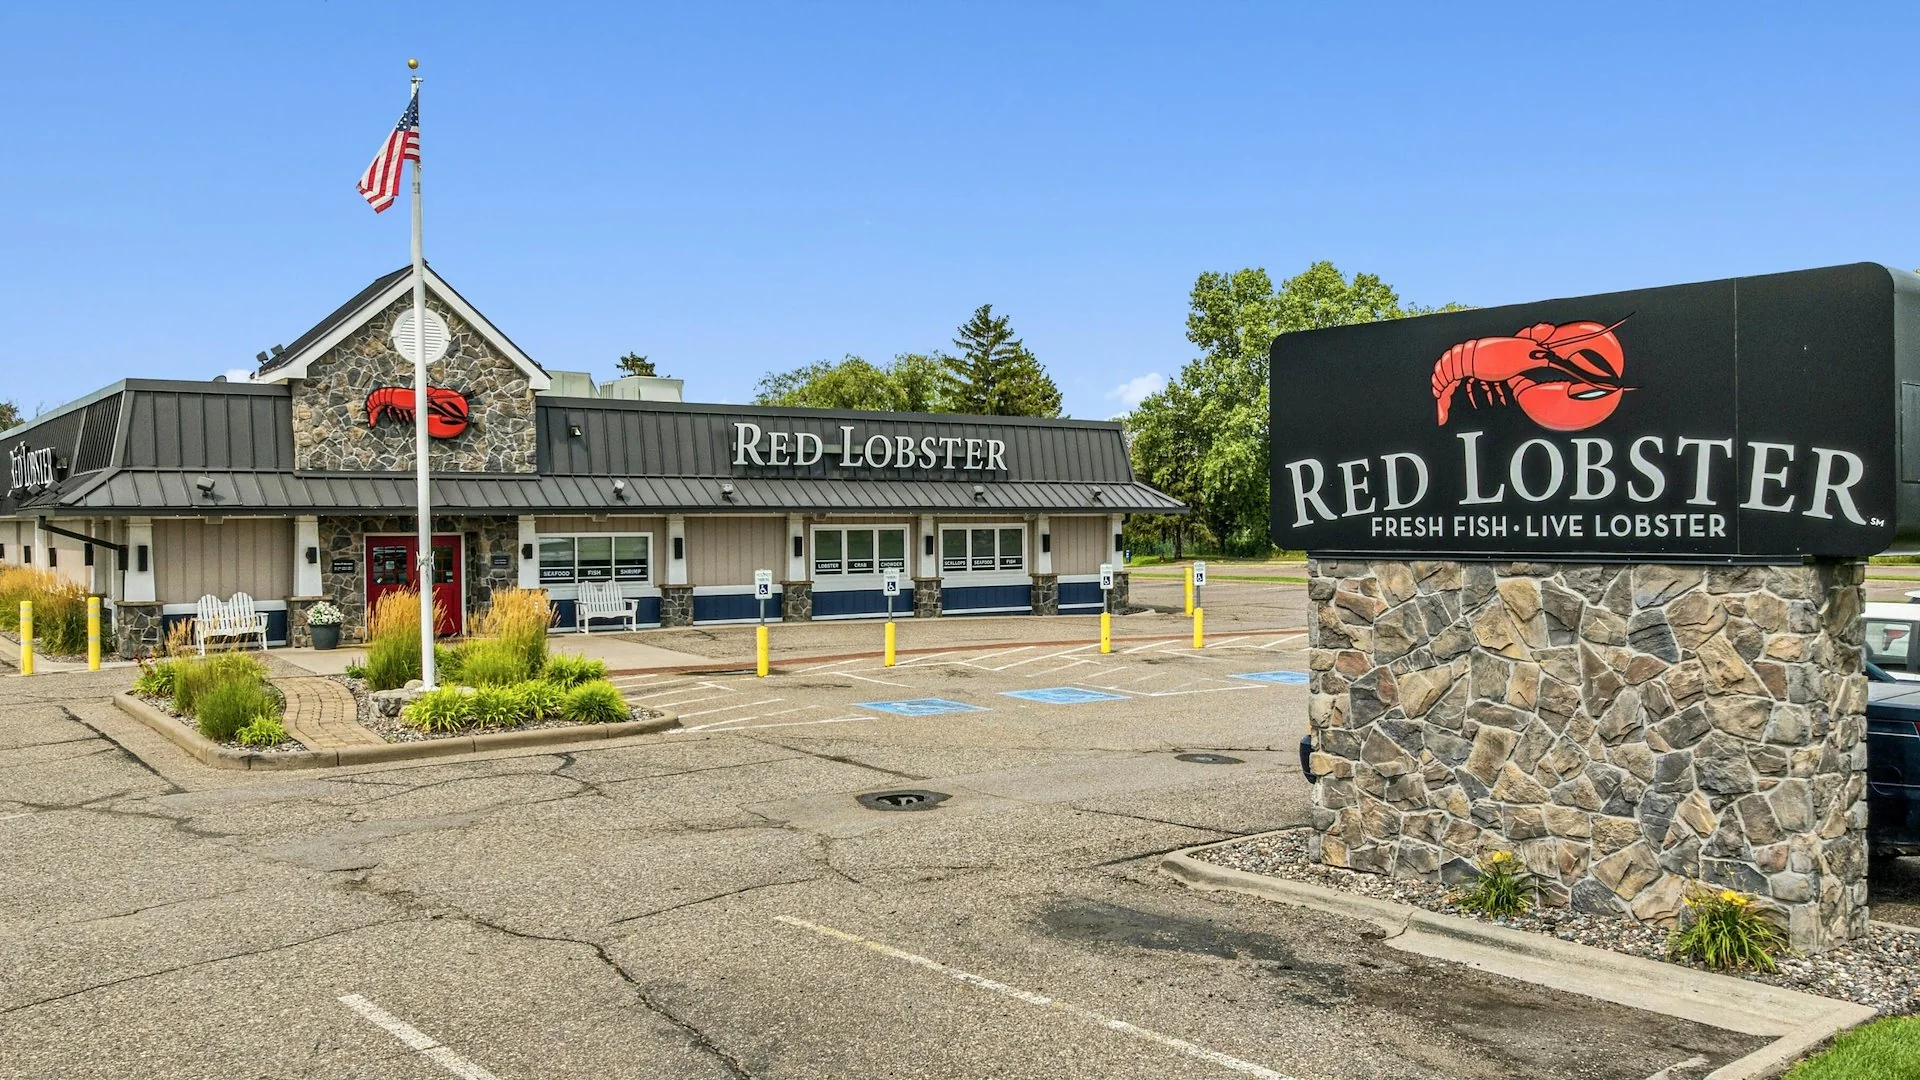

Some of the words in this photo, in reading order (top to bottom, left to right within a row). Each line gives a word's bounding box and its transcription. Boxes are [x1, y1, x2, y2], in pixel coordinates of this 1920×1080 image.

[732, 422, 823, 467] RED
[839, 425, 1008, 471] LOBSTER
[1285, 452, 1429, 528] RED
[1455, 430, 1867, 526] LOBSTER
[1371, 516, 1444, 537] FRESH
[1453, 515, 1507, 537] FISH
[1526, 515, 1583, 537] LIVE
[1595, 513, 1726, 537] LOBSTER
[1870, 517, 1885, 527] SM
